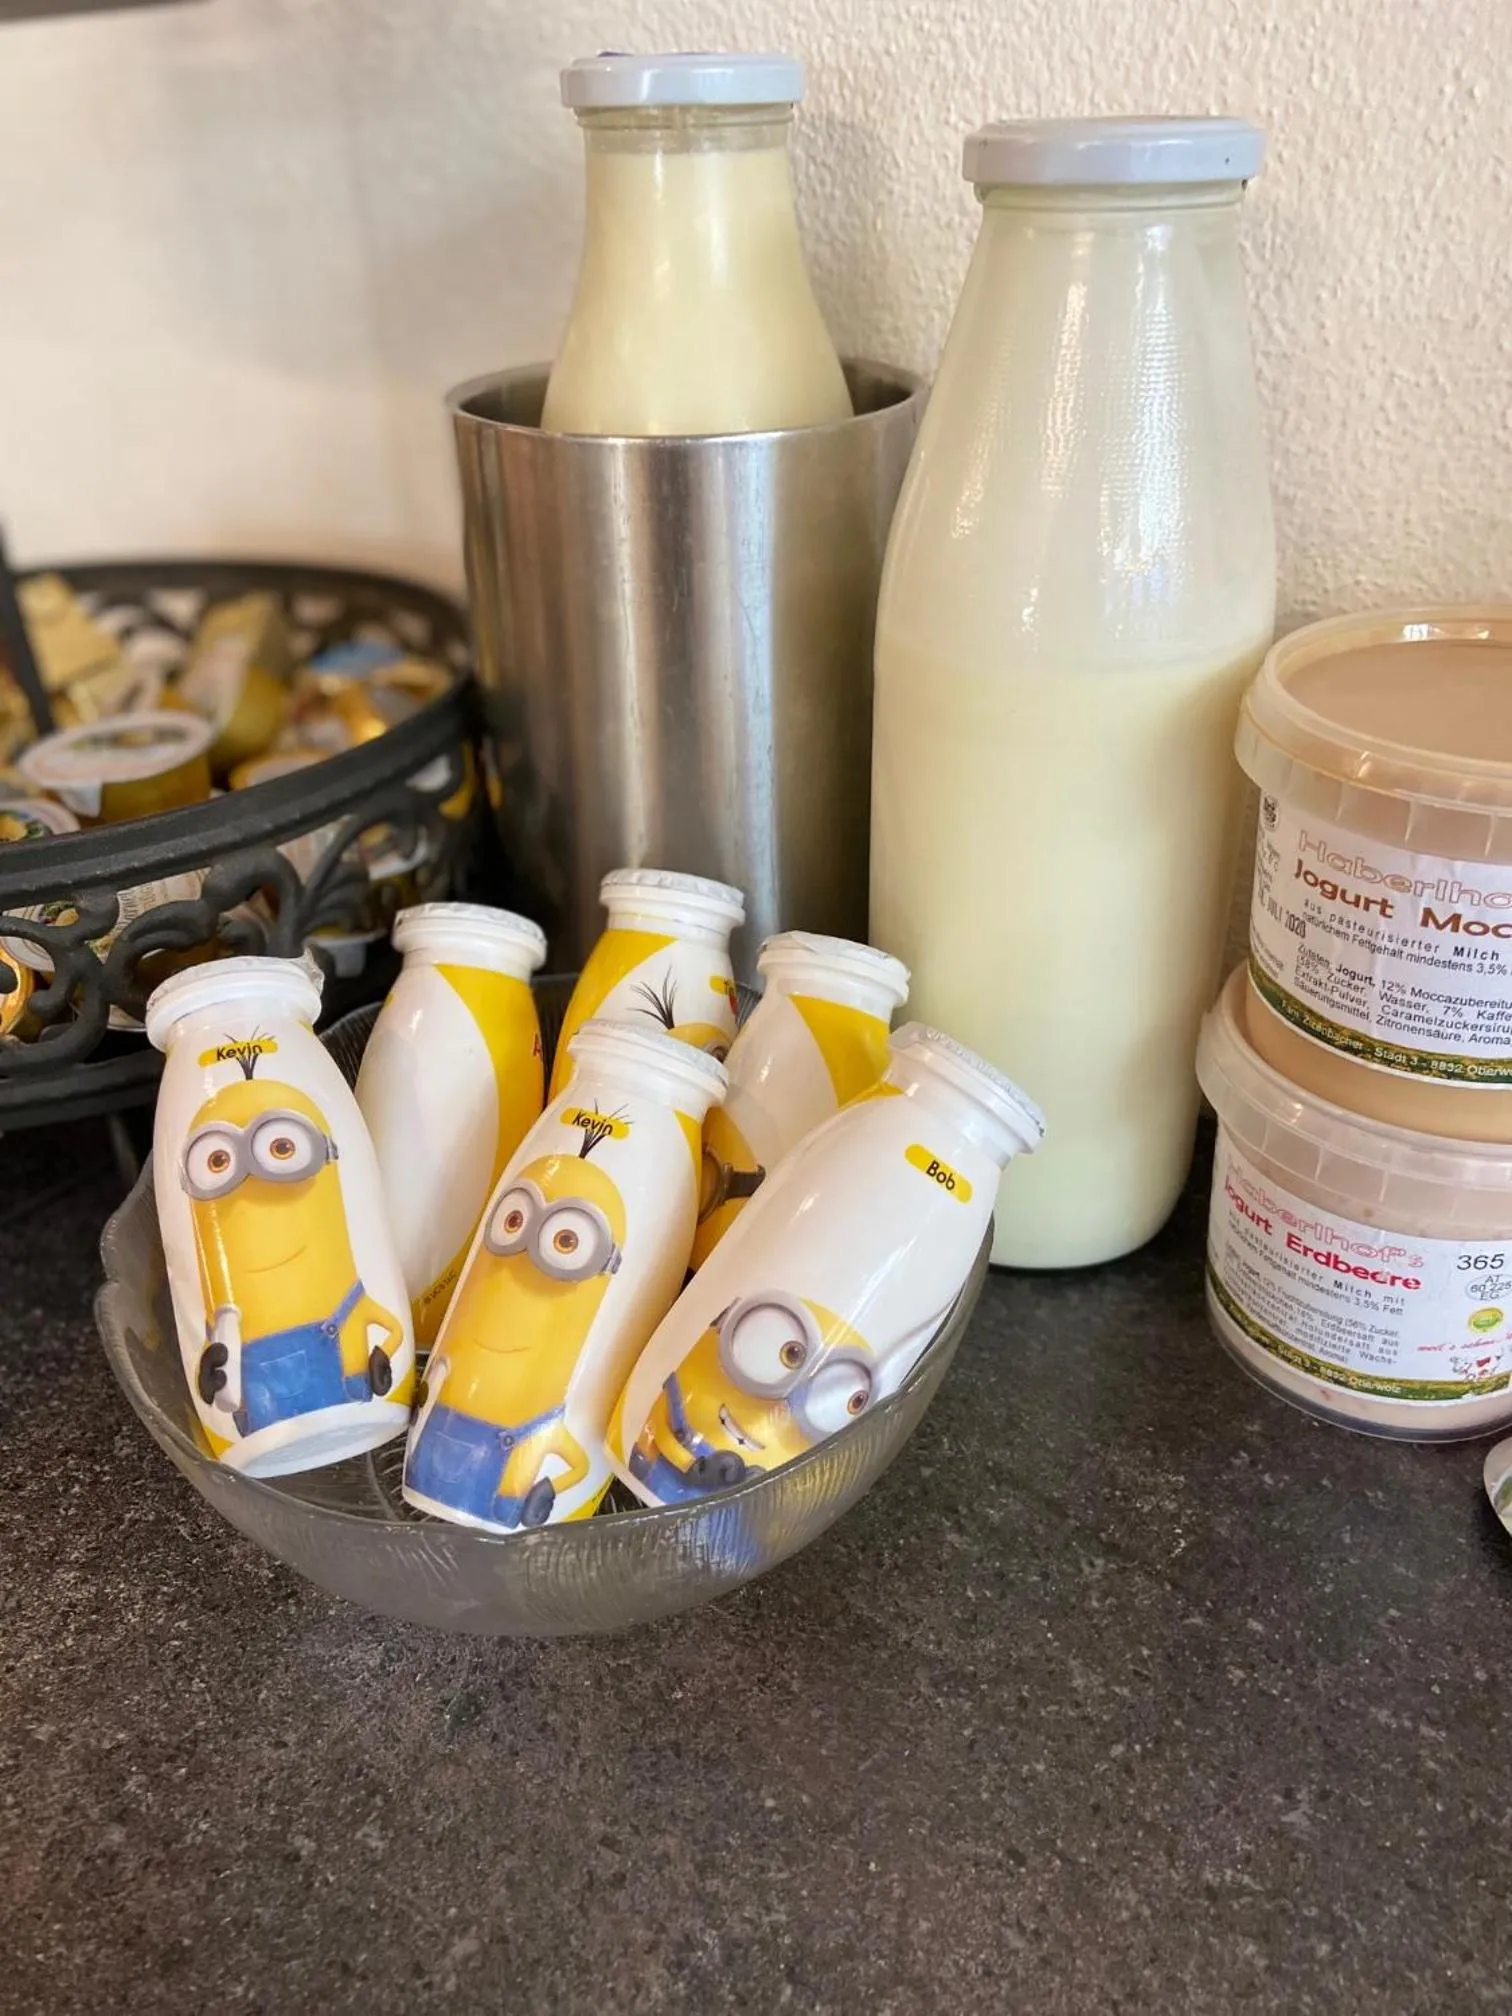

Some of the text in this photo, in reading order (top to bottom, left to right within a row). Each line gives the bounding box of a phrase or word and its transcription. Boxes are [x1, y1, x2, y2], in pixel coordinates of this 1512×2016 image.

[1294, 858, 1395, 919] Jogurt
[1453, 945, 1500, 961] Milch
[1406, 953, 1463, 973] mindestens
[1476, 962, 1508, 976] 3,5%
[1382, 979, 1407, 994] 12%
[1443, 1004, 1463, 1018] 7%
[216, 1042, 263, 1061] Kevin
[1374, 1046, 1406, 1064] Stadt
[571, 1110, 614, 1136] Kevin
[926, 1159, 956, 1191] Bob
[1456, 1253, 1505, 1271] 365
[1333, 1279, 1372, 1299] Milch
